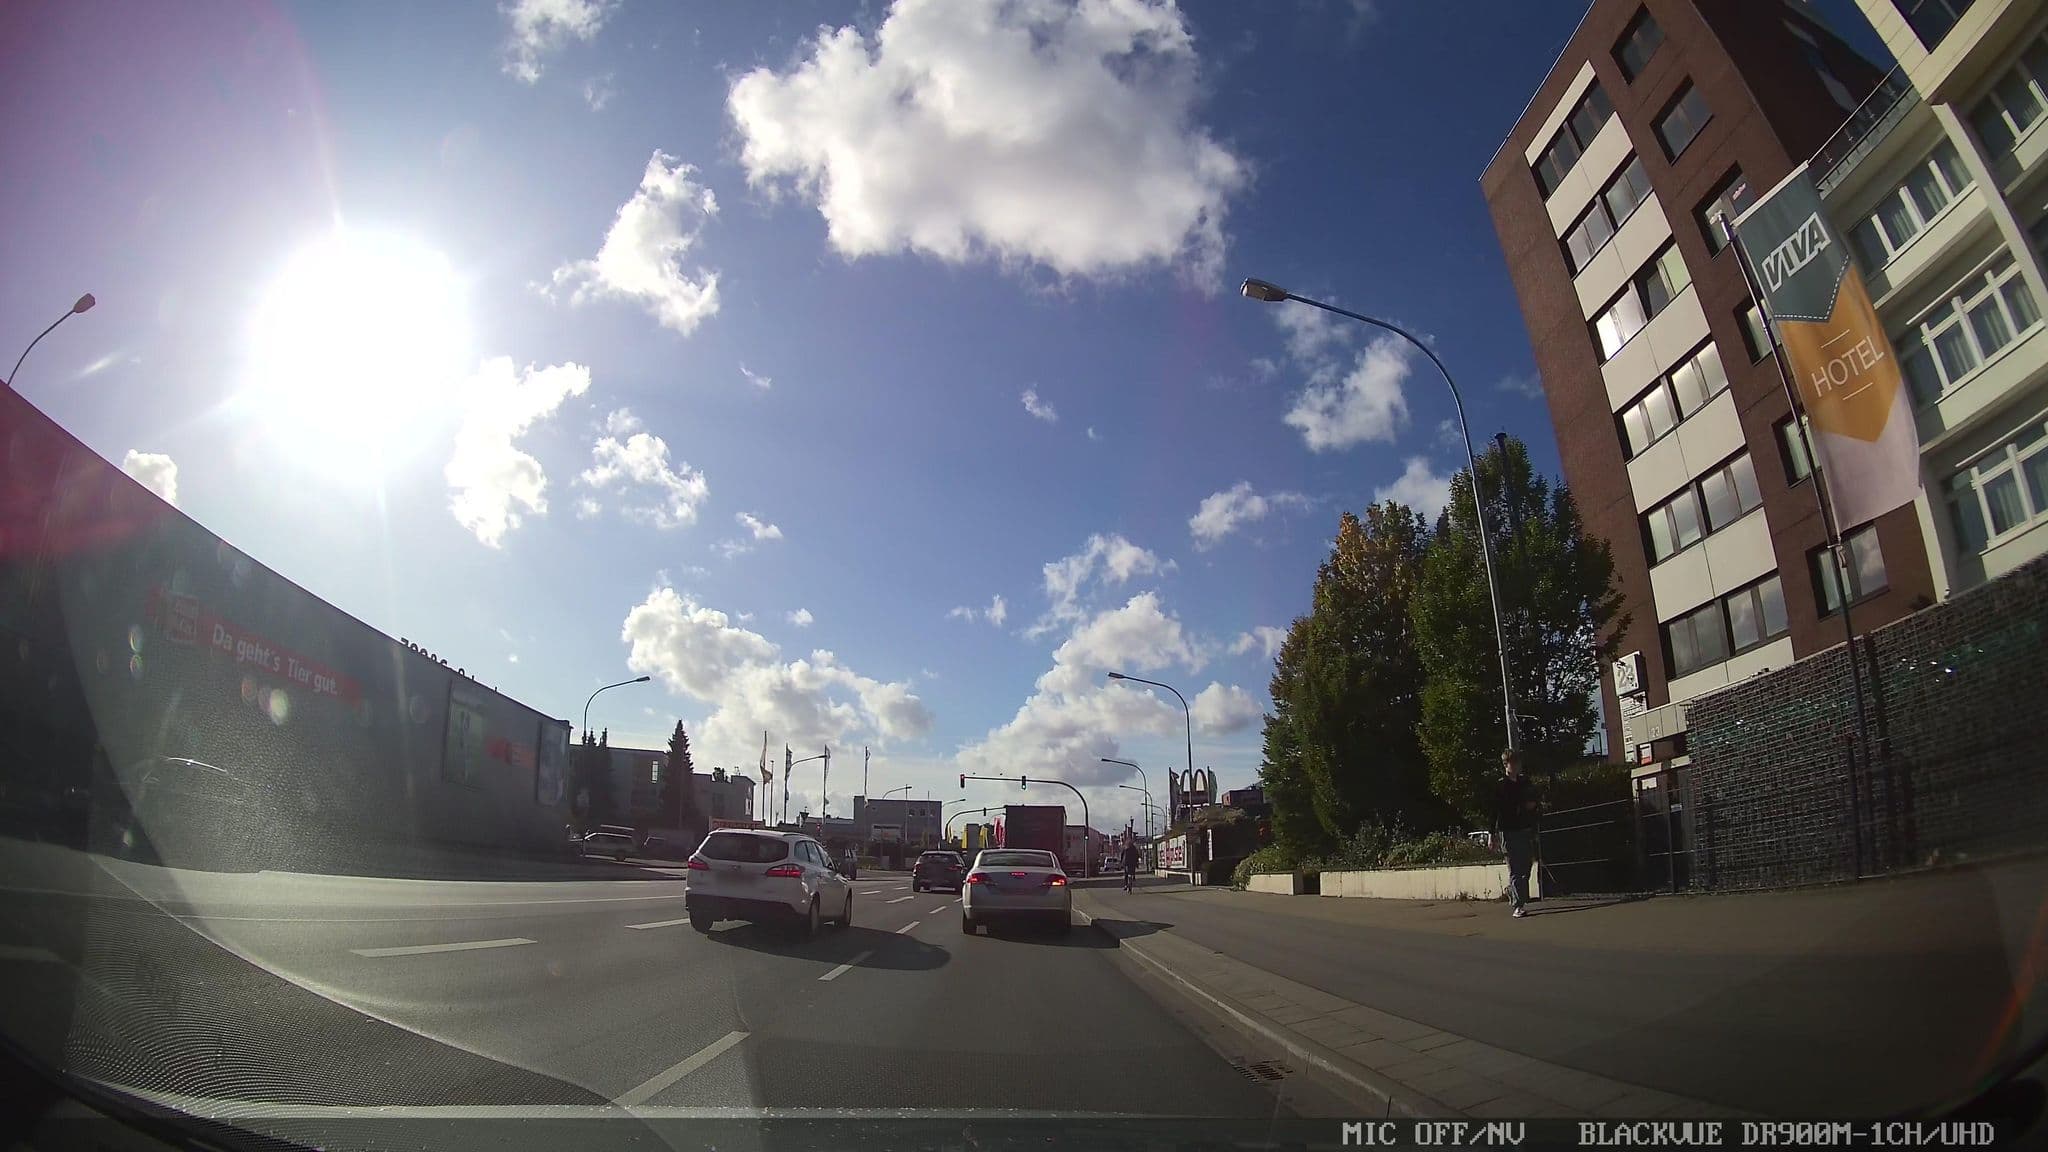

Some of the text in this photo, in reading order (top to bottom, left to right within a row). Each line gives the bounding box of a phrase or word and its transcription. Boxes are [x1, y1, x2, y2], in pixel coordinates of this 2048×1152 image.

[1761, 211, 1832, 292] VIVA
[1811, 336, 1885, 398] HOTEL
[212, 623, 233, 650] Da
[287, 657, 312, 684] Tier
